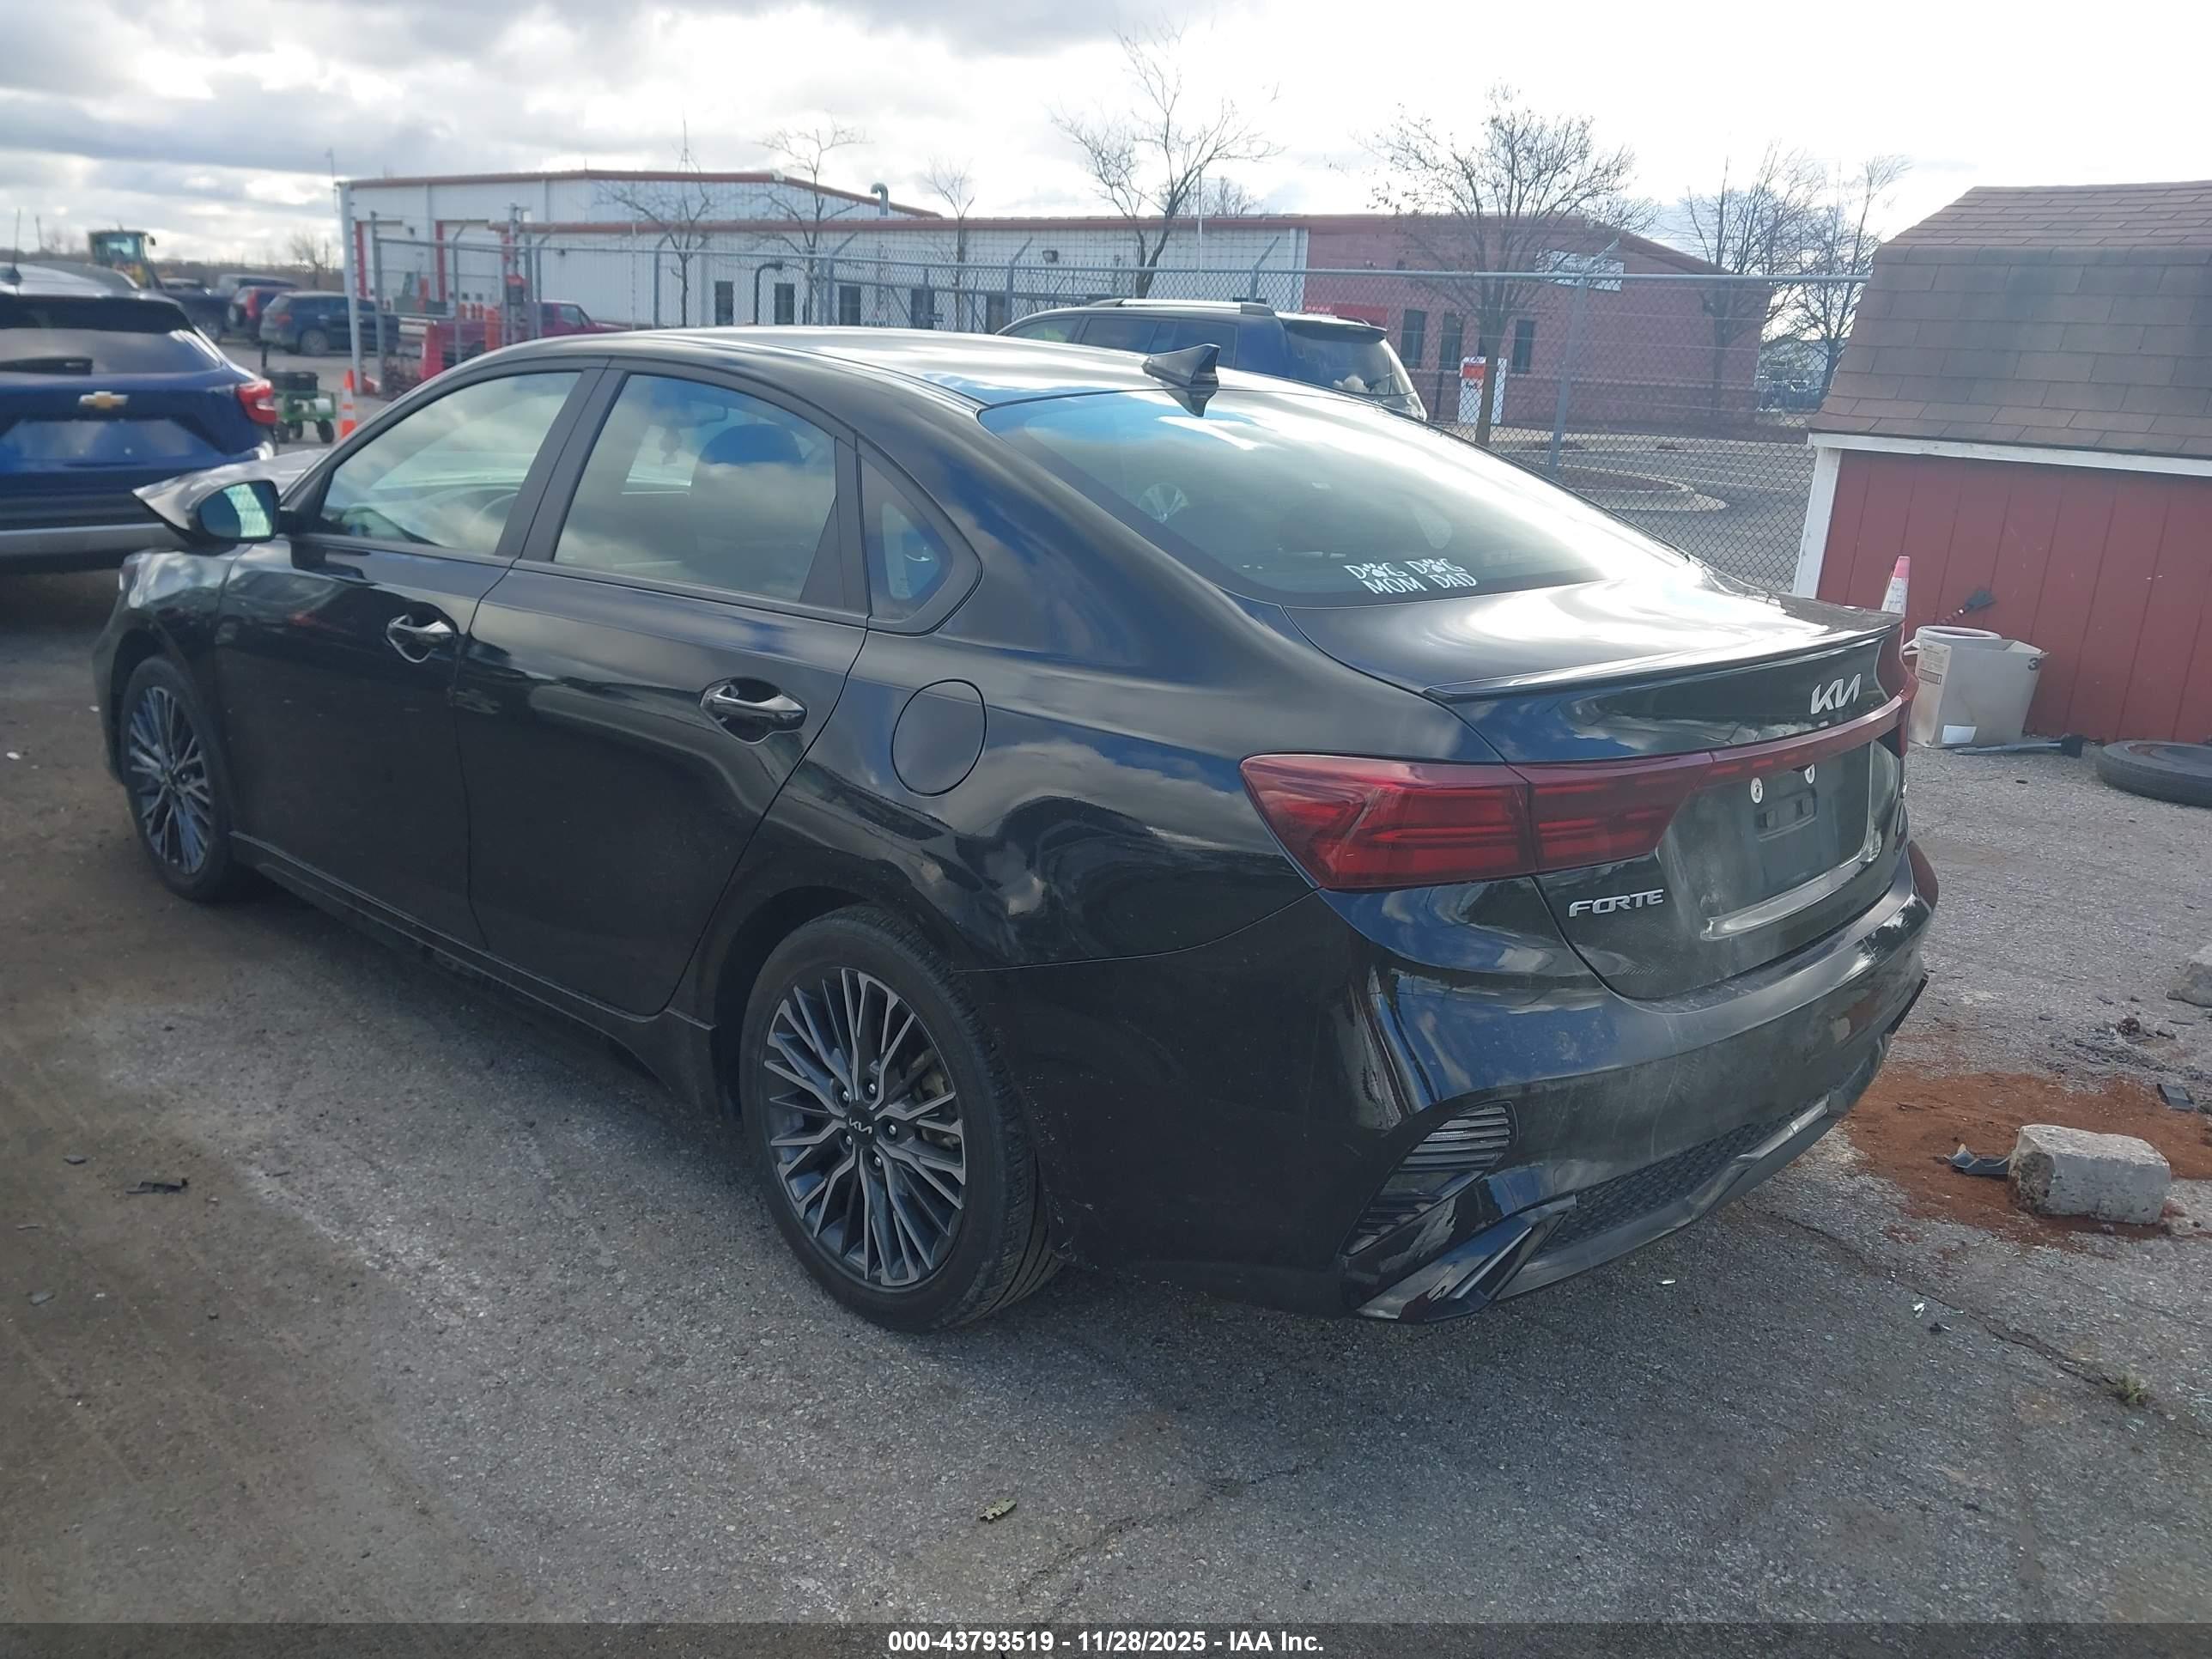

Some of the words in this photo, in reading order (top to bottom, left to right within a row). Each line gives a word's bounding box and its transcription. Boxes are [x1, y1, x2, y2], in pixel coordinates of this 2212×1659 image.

[1362, 577, 1428, 594] MOM
[1429, 573, 1477, 588] DAD
[1569, 889, 1664, 917] FORTE
